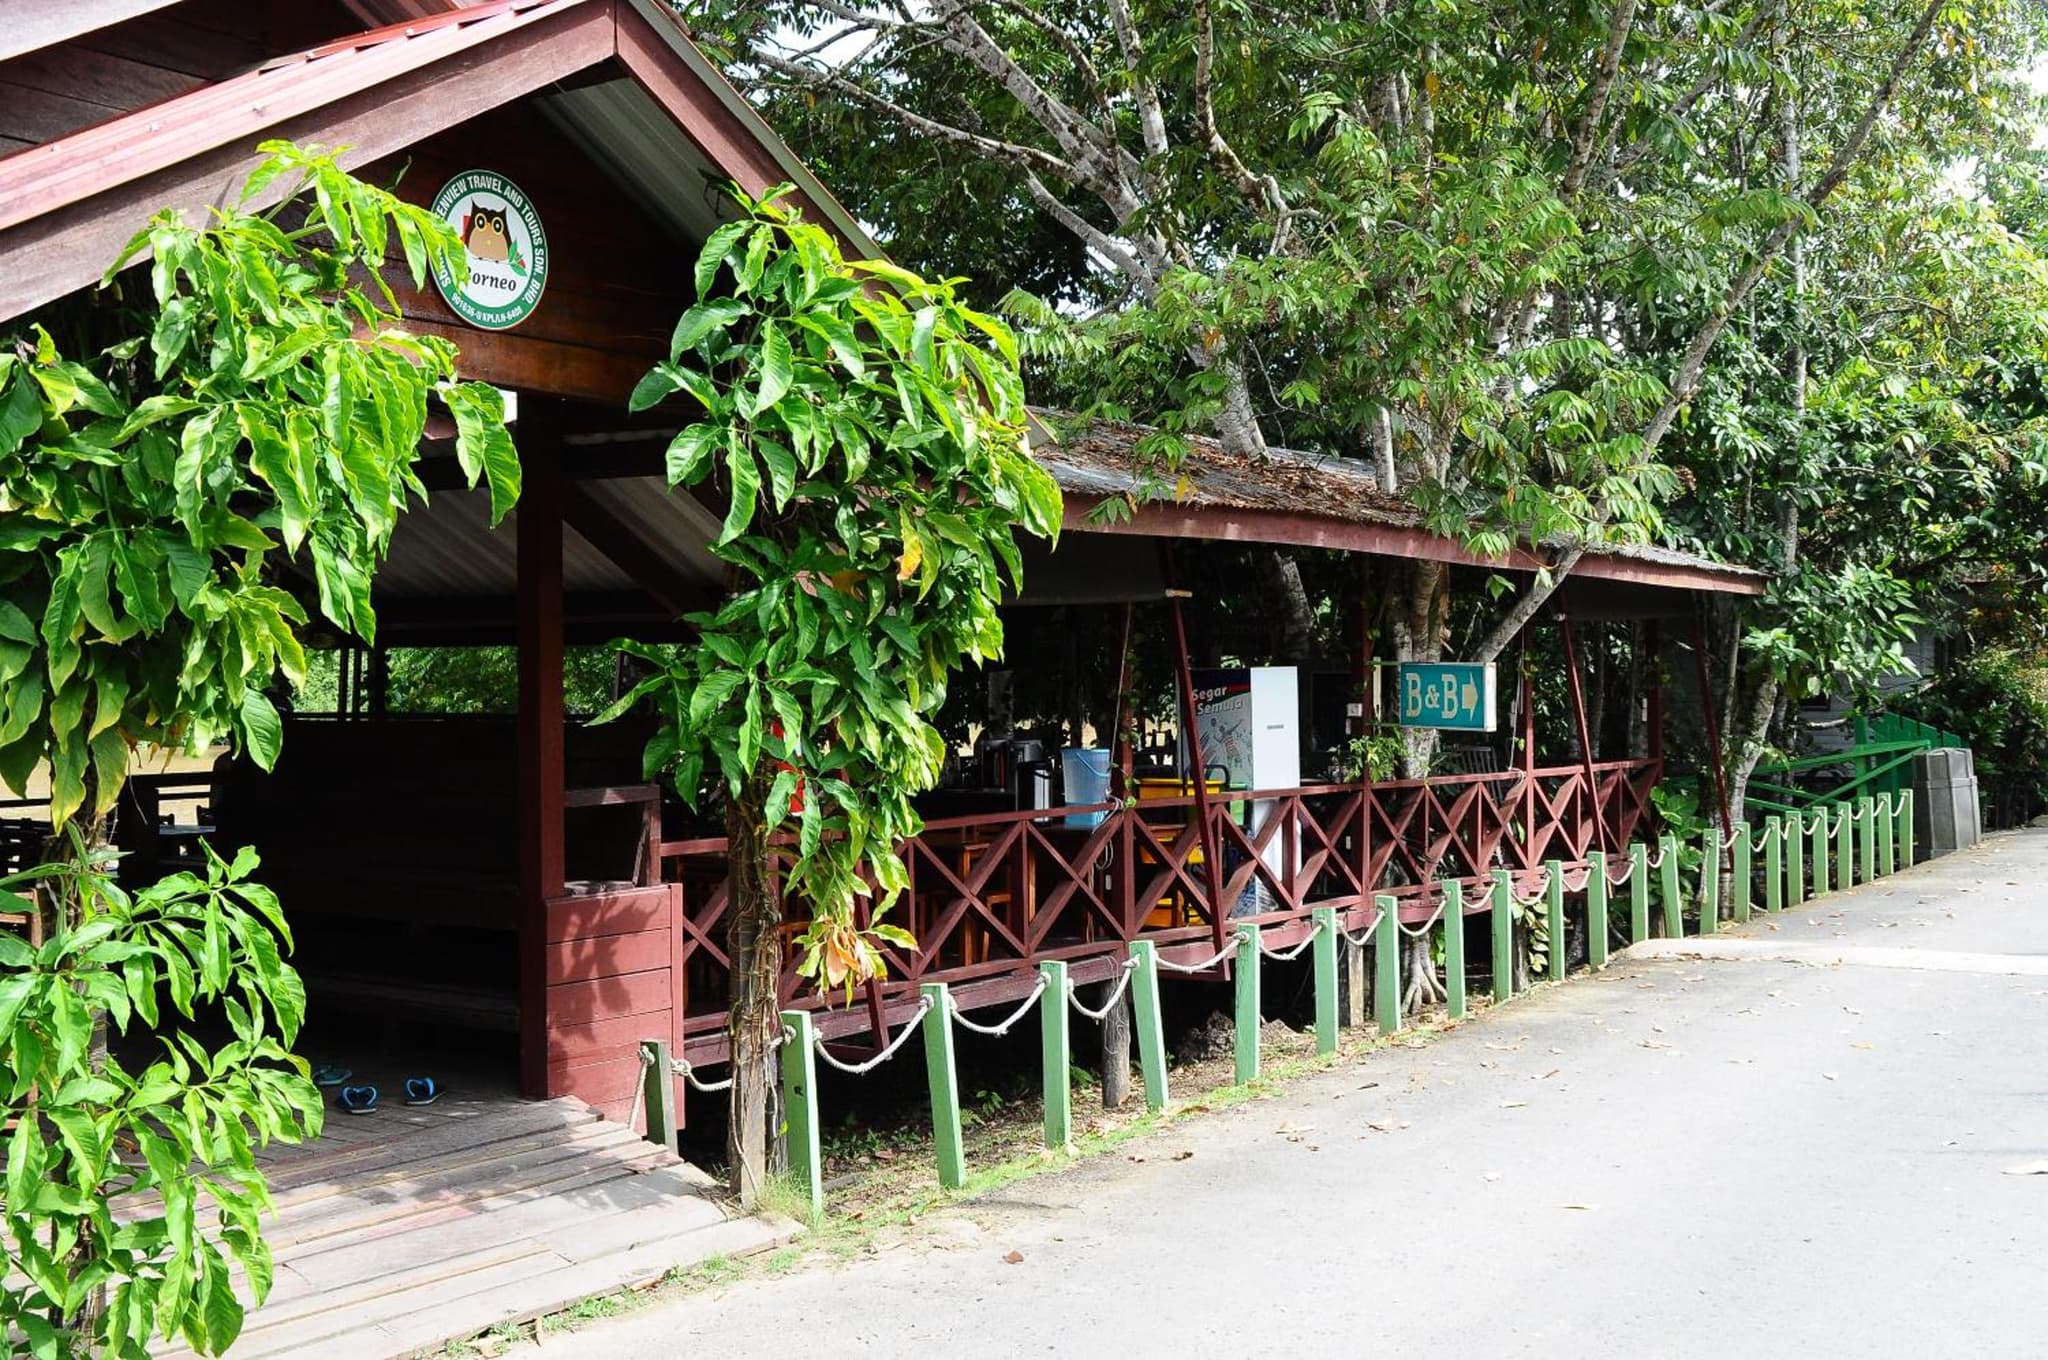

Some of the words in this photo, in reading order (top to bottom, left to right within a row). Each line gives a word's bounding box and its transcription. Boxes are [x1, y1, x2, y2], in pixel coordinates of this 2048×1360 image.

[467, 174, 503, 193] TRAVEL
[503, 186, 522, 208] AND
[521, 205, 544, 247] TOURS
[523, 279, 541, 305] BHD.
[1192, 686, 1228, 702] Segar
[1405, 672, 1459, 720] B&B
[1197, 698, 1244, 715] Semula
